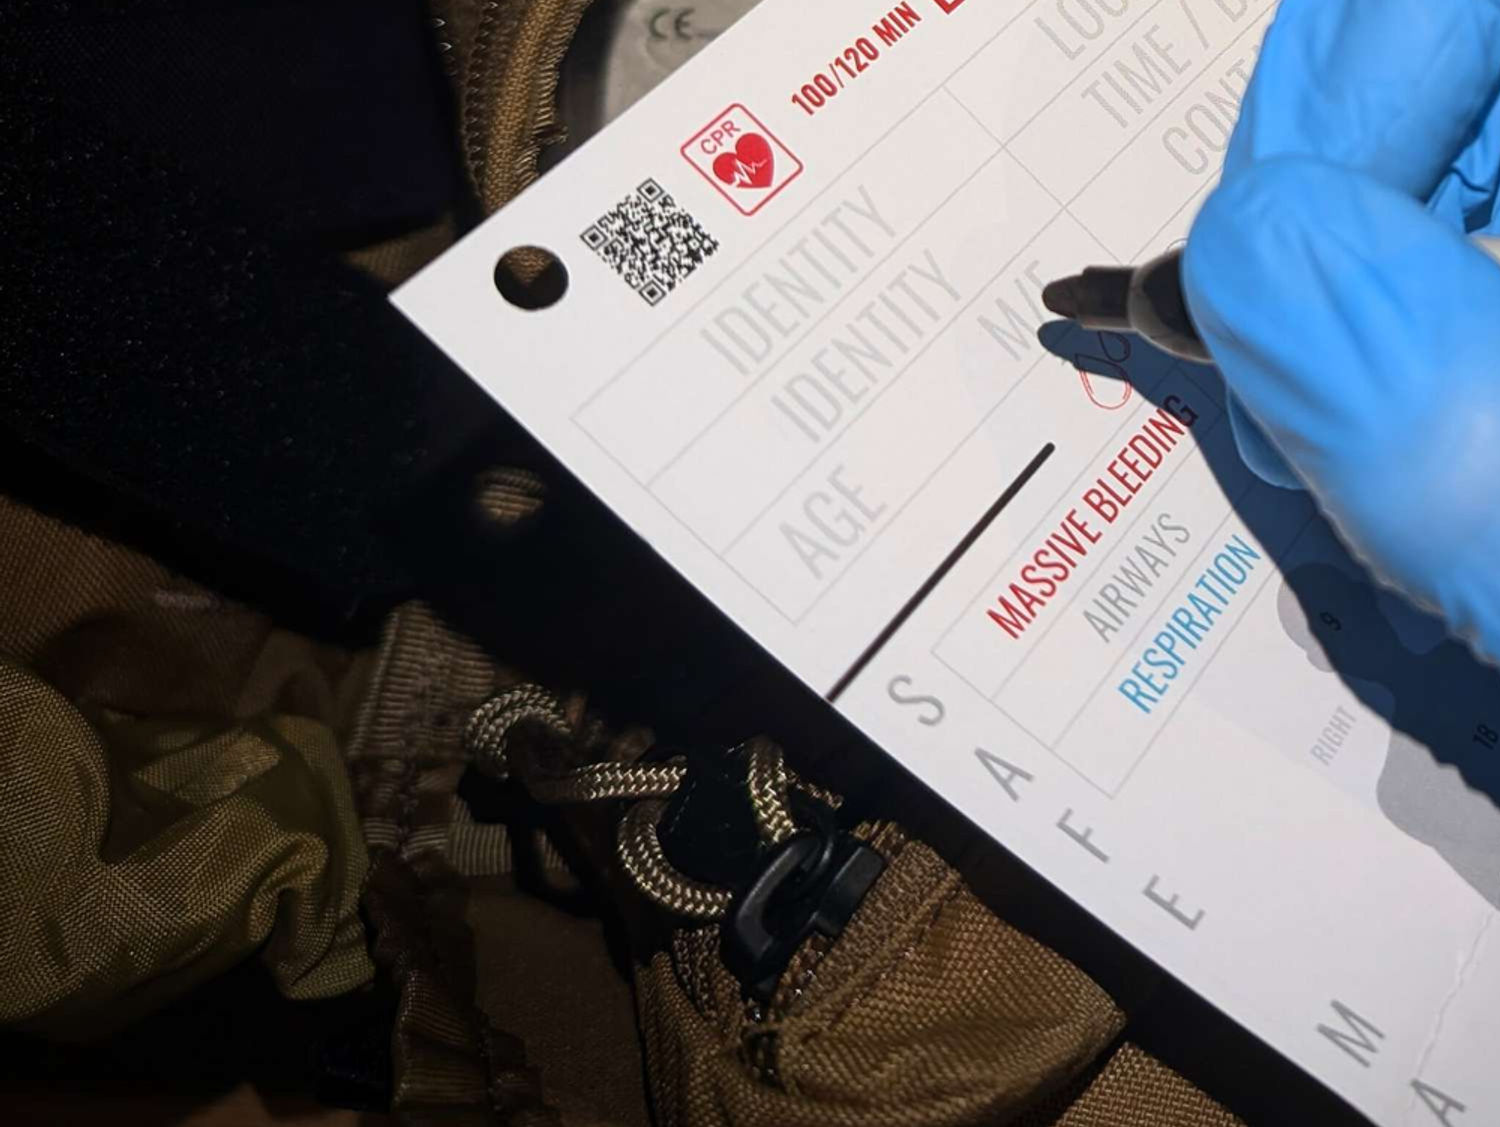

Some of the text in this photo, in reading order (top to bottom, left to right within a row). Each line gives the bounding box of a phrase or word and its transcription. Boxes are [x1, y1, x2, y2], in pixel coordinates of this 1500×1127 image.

[791, 1, 922, 116] 100/120 MIN
[1081, 24, 1192, 128] TIME
[700, 119, 741, 155] CPR
[701, 184, 896, 375] IDENTITY
[771, 248, 961, 443] IDENTITY
[779, 464, 888, 580] AGE
[987, 394, 1199, 640] MASSIVE BLEEDING
[1082, 512, 1191, 644] AIRWAYS
[1118, 533, 1261, 715] RESPIRATION
[1310, 705, 1357, 766] RIGHT
